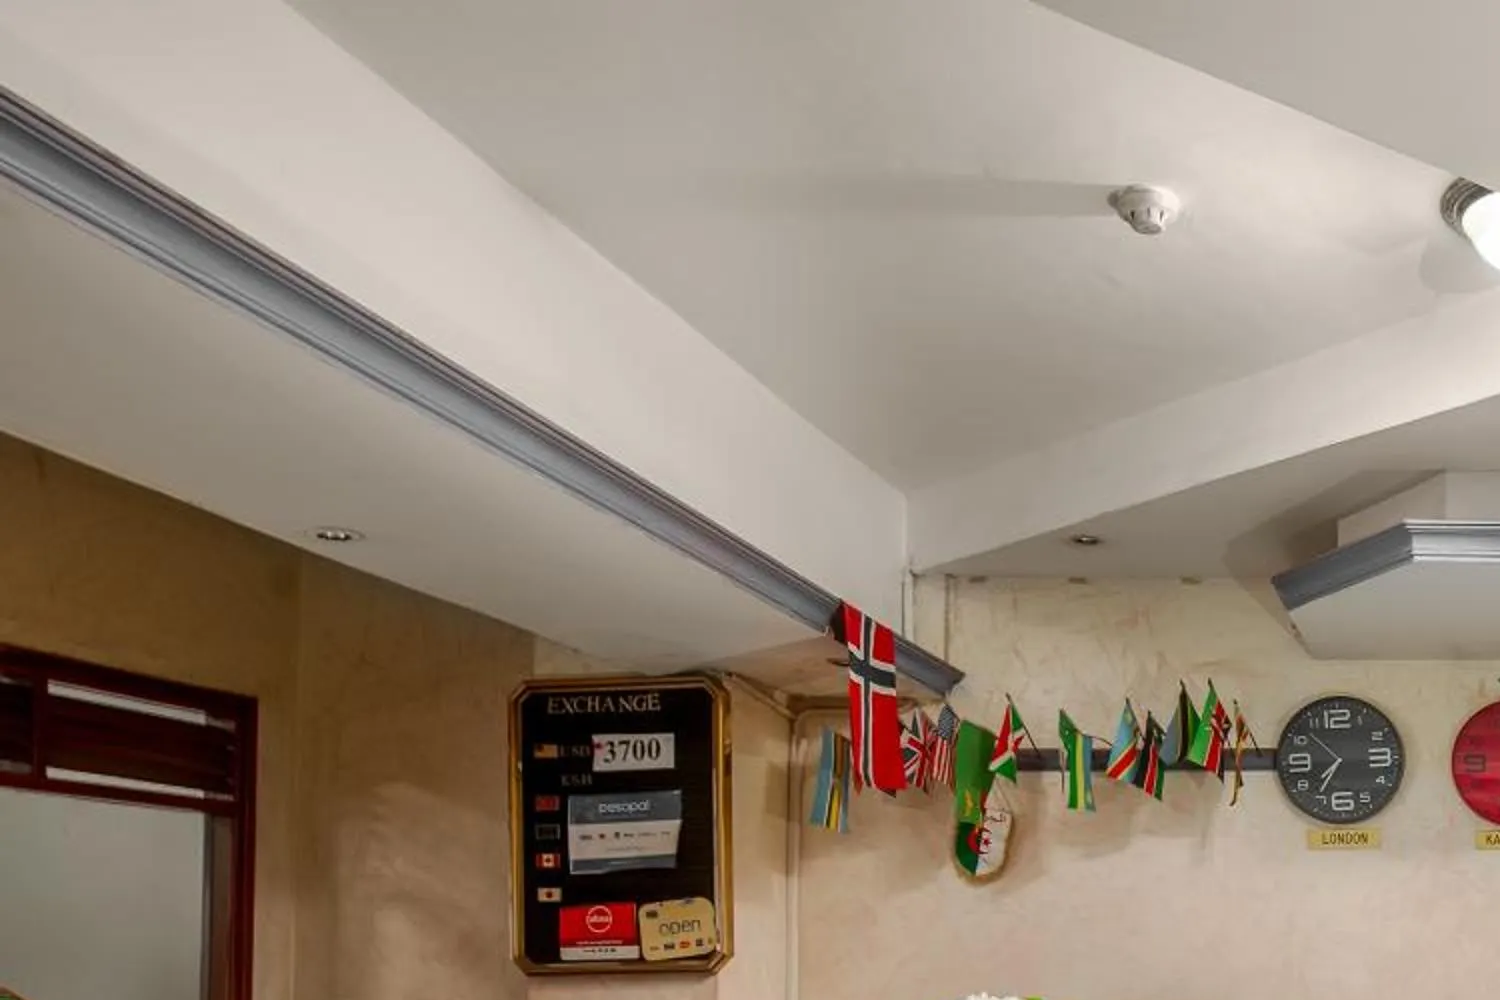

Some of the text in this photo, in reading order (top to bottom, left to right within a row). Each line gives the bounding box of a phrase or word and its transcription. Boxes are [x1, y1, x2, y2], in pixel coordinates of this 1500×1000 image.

[547, 692, 662, 715] EXCHANGE
[1323, 709, 1352, 729] 12
[603, 738, 662, 764] 3700
[1368, 747, 1392, 768] 3
[1289, 753, 1311, 773] 9
[1331, 791, 1355, 811] 6
[1321, 832, 1369, 845] LONDON
[659, 918, 702, 937] open
